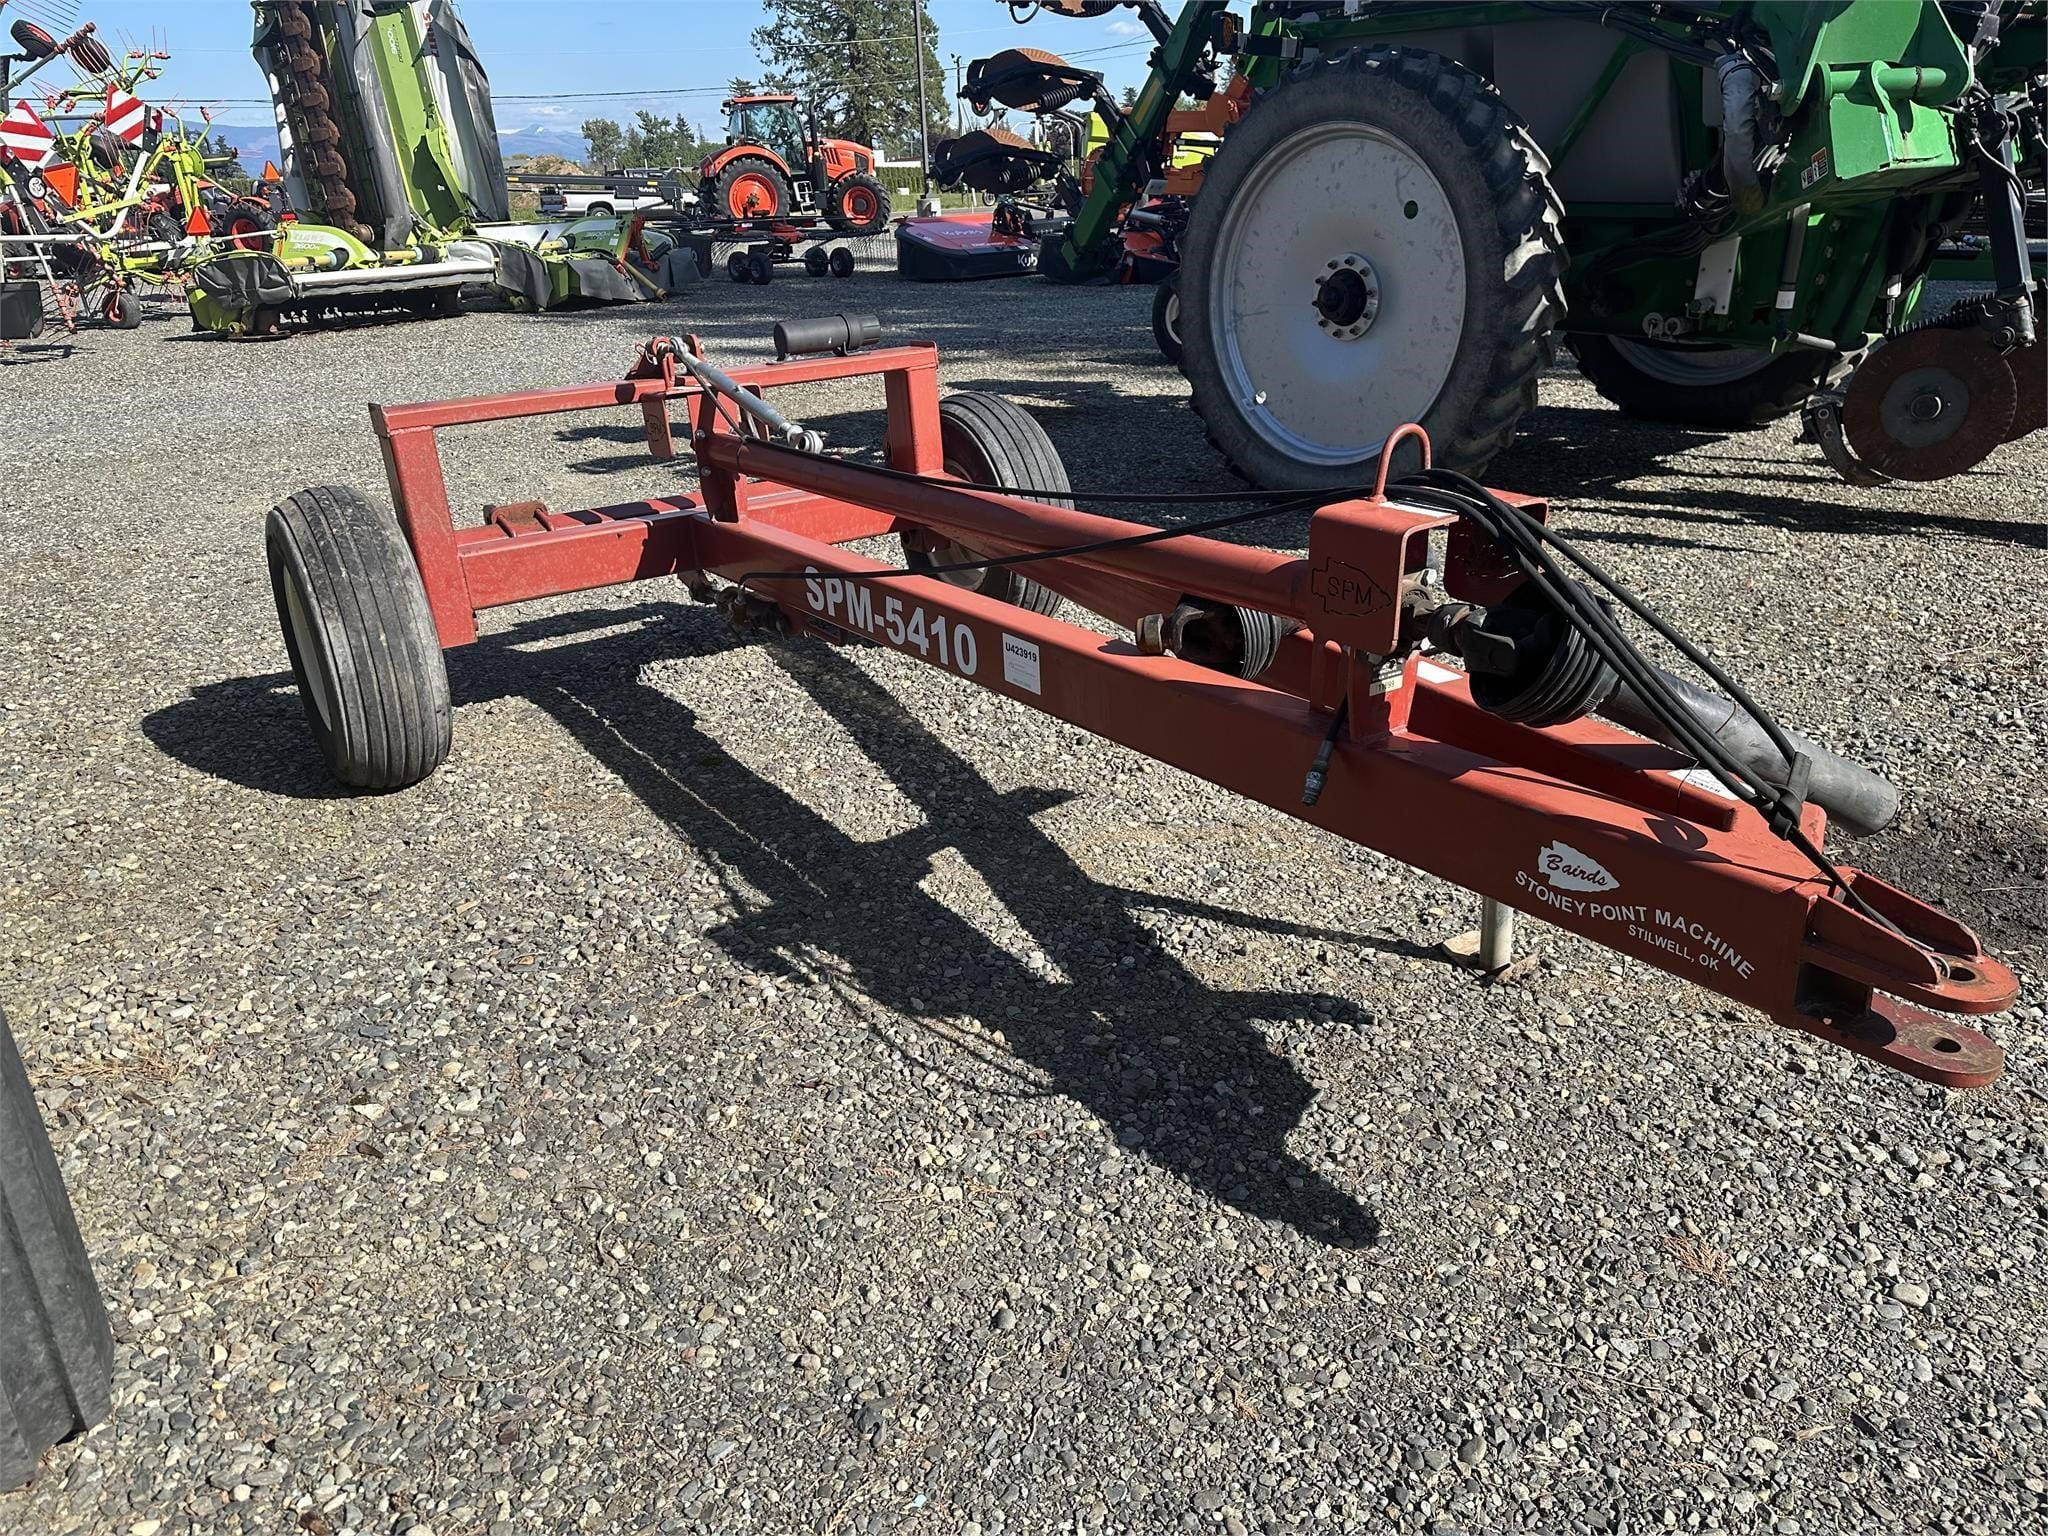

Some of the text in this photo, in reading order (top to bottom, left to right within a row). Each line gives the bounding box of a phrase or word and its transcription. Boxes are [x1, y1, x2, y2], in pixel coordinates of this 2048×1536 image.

[1327, 576, 1372, 607] SPM
[805, 566, 977, 675] SPM-5410
[1005, 641, 1037, 663] U423919
[1546, 854, 1608, 887] Bairds
[1515, 870, 1756, 979] STONEY POINT MACHINE
[1628, 924, 1719, 972] STILWELL, OK
